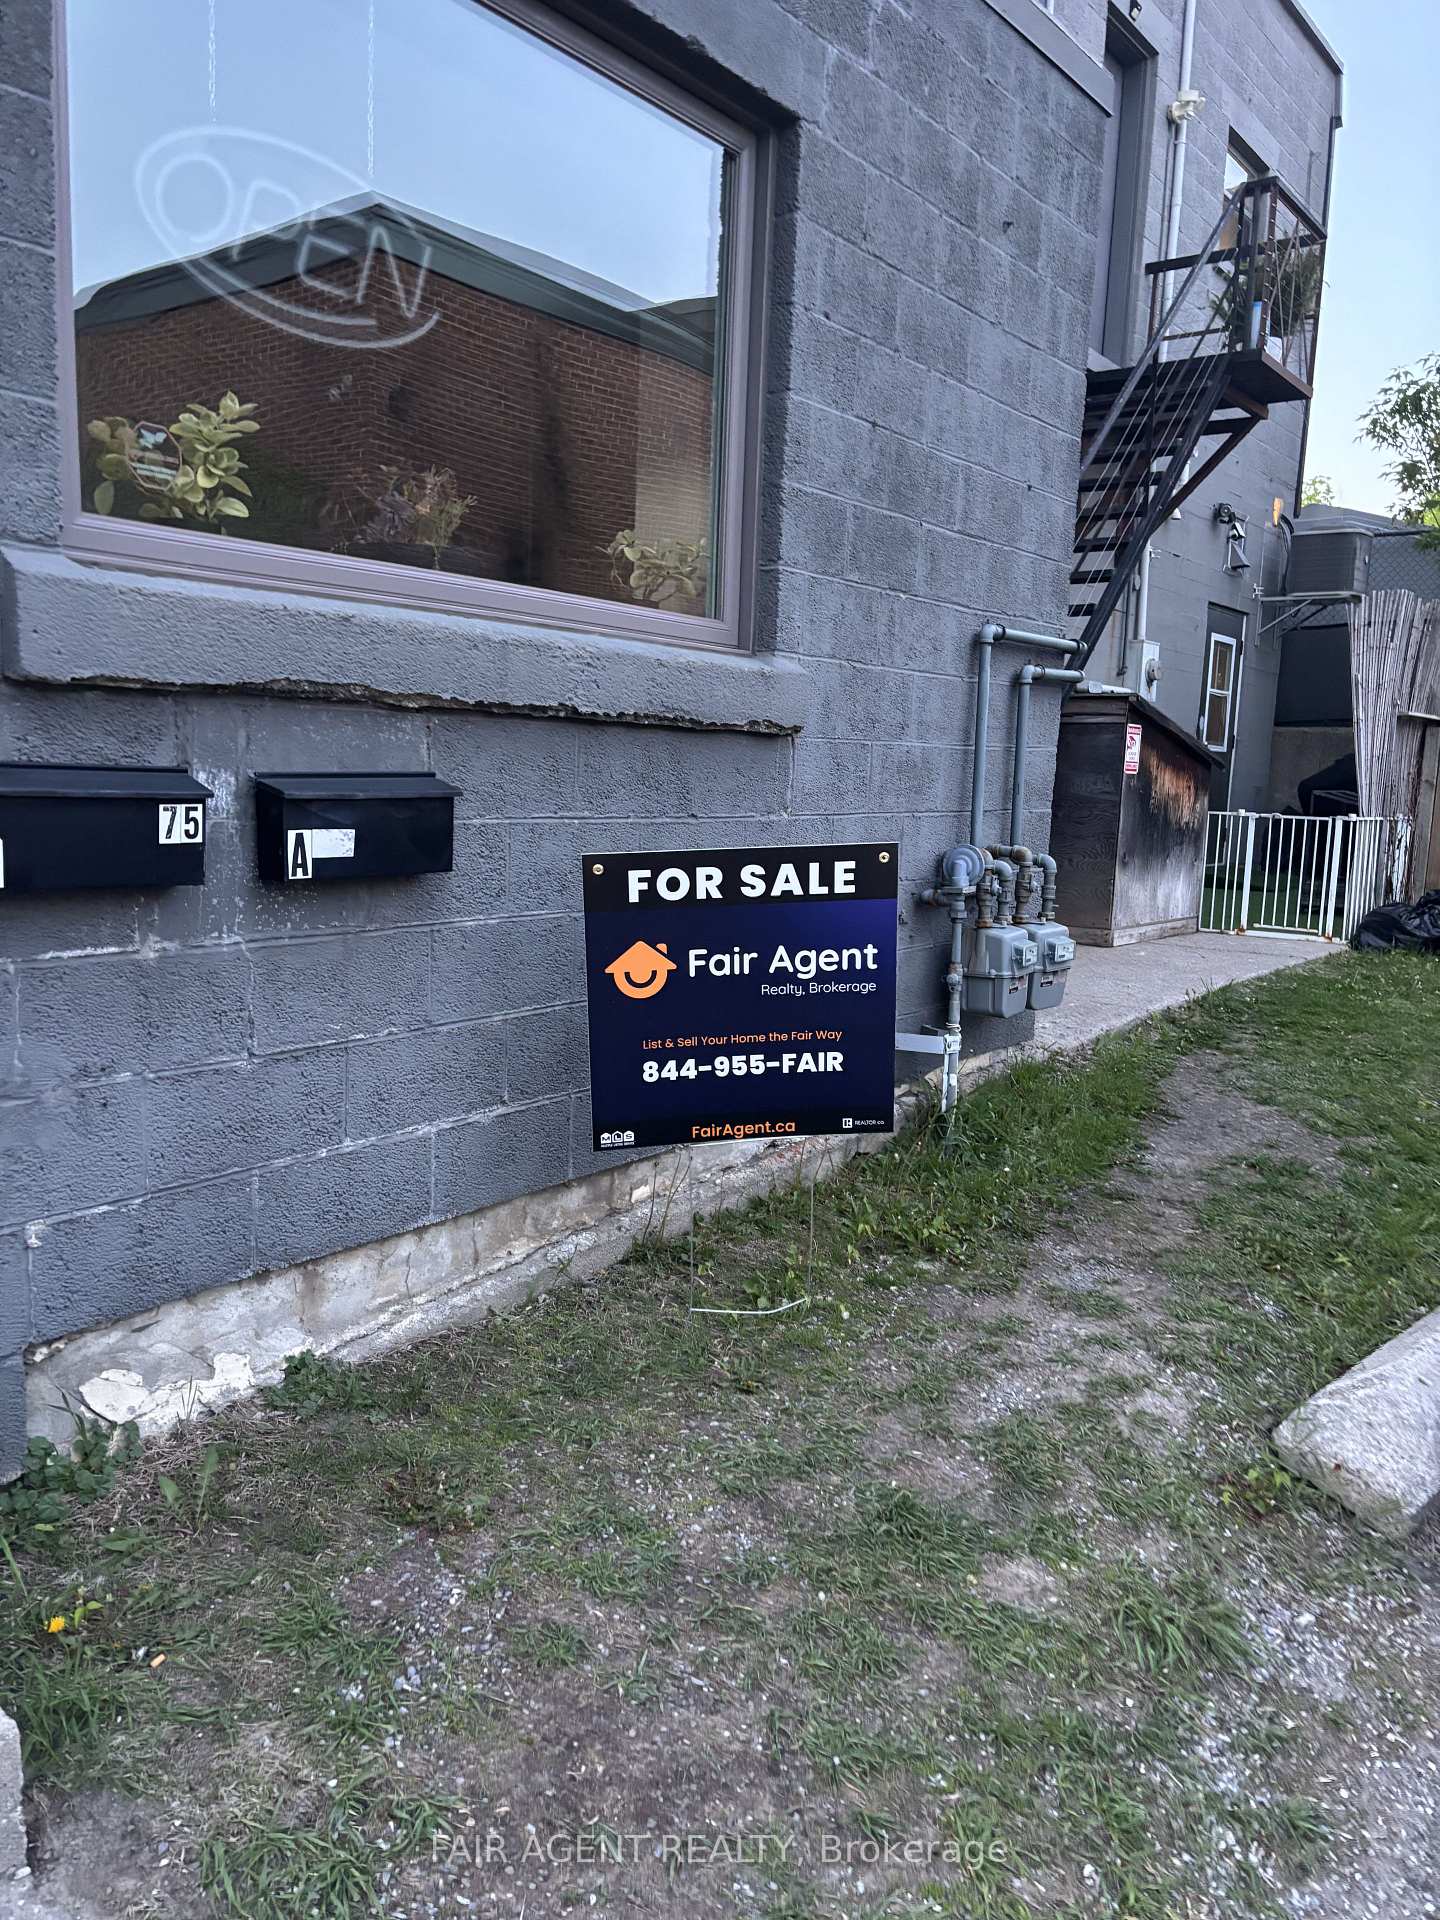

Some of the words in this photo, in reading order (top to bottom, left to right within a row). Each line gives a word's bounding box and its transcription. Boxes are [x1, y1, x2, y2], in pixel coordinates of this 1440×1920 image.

[154, 151, 433, 320] OPEN
[163, 805, 200, 840] 75
[290, 831, 310, 878] A
[627, 866, 723, 903] FOR
[739, 860, 856, 898] SALE
[688, 946, 758, 978] Fair
[768, 943, 878, 980] Agent
[761, 983, 806, 997] Realty,
[809, 981, 877, 995] Brokerage
[642, 1038, 663, 1050] List
[665, 1038, 674, 1048] &
[677, 1036, 698, 1047] Sell
[701, 1034, 728, 1046] Your
[731, 1033, 766, 1044] Home
[768, 1031, 789, 1042] the
[791, 1030, 813, 1041] Fair
[815, 1029, 843, 1042] Way
[641, 1051, 844, 1083] 844-955-FAIR
[600, 1130, 635, 1145] MLS
[691, 1120, 796, 1140] FairAgent.ca
